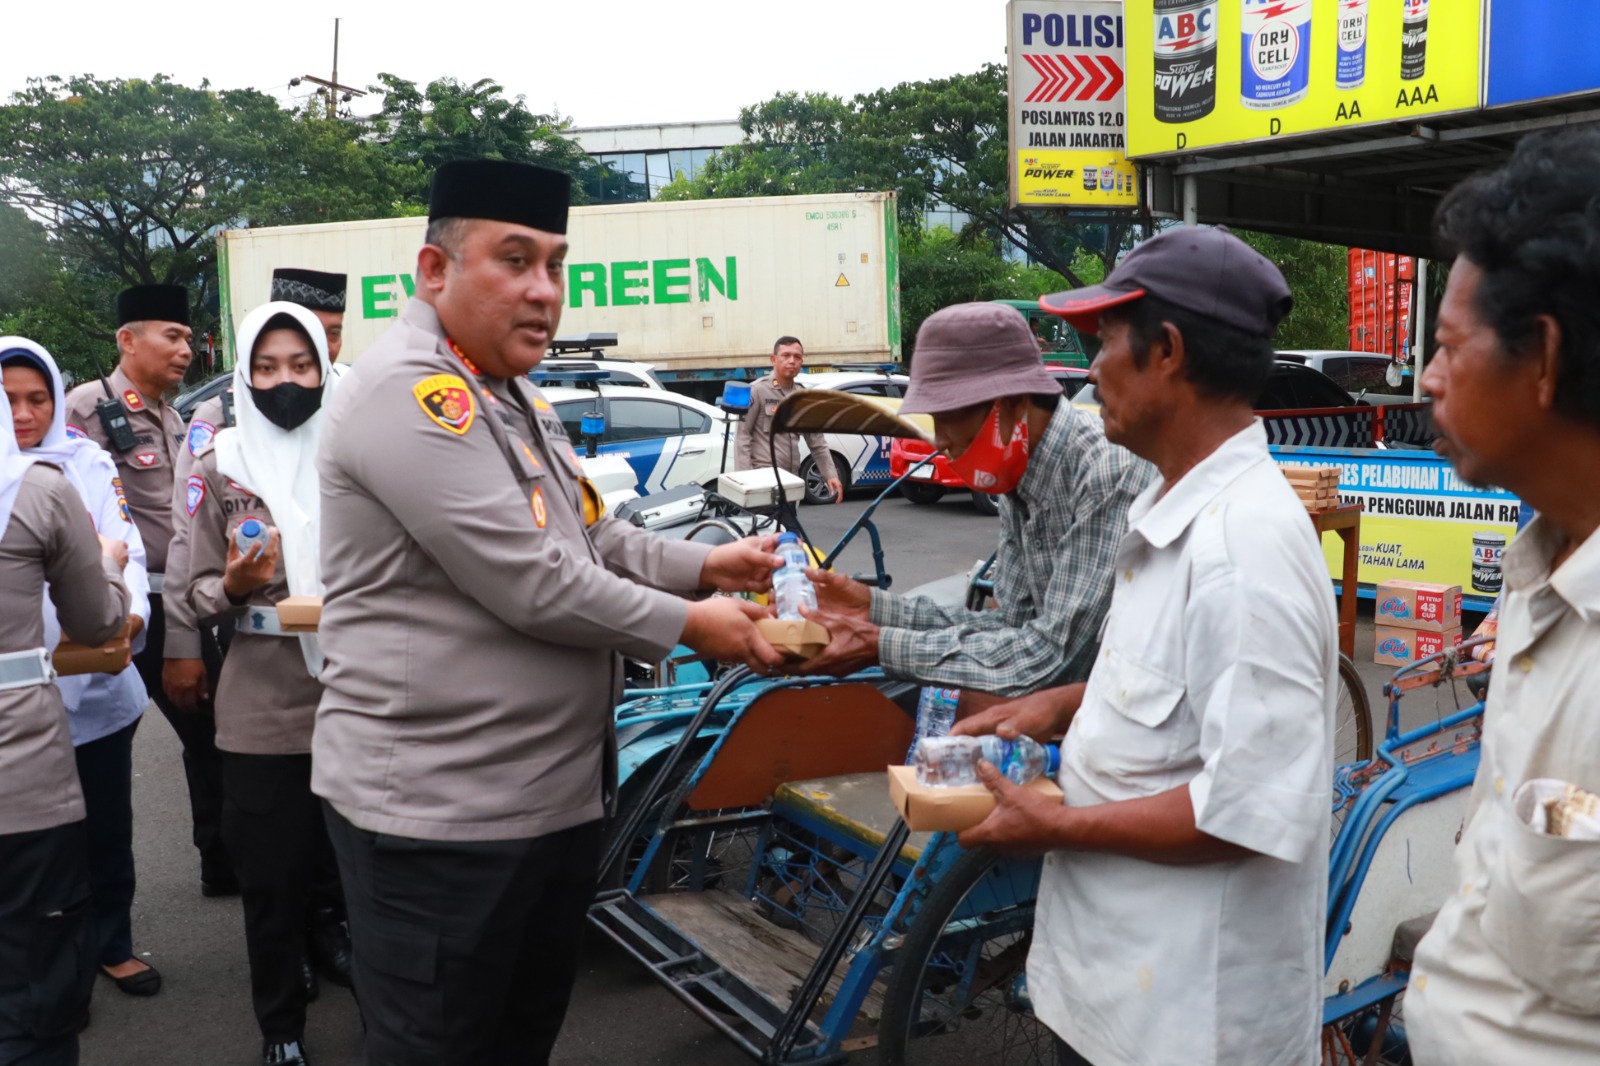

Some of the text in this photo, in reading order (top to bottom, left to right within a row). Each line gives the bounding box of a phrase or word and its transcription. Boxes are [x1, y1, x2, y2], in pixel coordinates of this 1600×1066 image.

[1158, 8, 1211, 39] ABC
[1343, 16, 1362, 28] DRY
[1022, 13, 1123, 48] POLISI
[1260, 29, 1289, 46] DRY
[1341, 29, 1362, 40] CELL
[1258, 48, 1290, 64] CELL
[1155, 65, 1215, 99] POWER
[1395, 84, 1439, 108] AAA
[1021, 110, 1095, 126] POSLANTAS
[1335, 100, 1362, 121] AA
[1270, 117, 1281, 136] D
[1029, 132, 1124, 148] JALAN JAKARTA
[1176, 133, 1187, 150] D
[1024, 169, 1074, 180] POWER
[361, 256, 738, 319] EREEN
[1361, 464, 1439, 490] PELABUHAN
[1368, 496, 1446, 517] PENGGUNA
[1449, 501, 1494, 521] JALAN
[1499, 505, 1520, 522] RA
[1376, 543, 1402, 556] KUAT,
[1475, 547, 1502, 559] ABC
[1362, 554, 1425, 570] TAHAN LAMA
[1382, 599, 1406, 612] Club
[1420, 602, 1437, 613] 48
[1381, 639, 1406, 653] Club
[1420, 643, 1436, 654] 48
